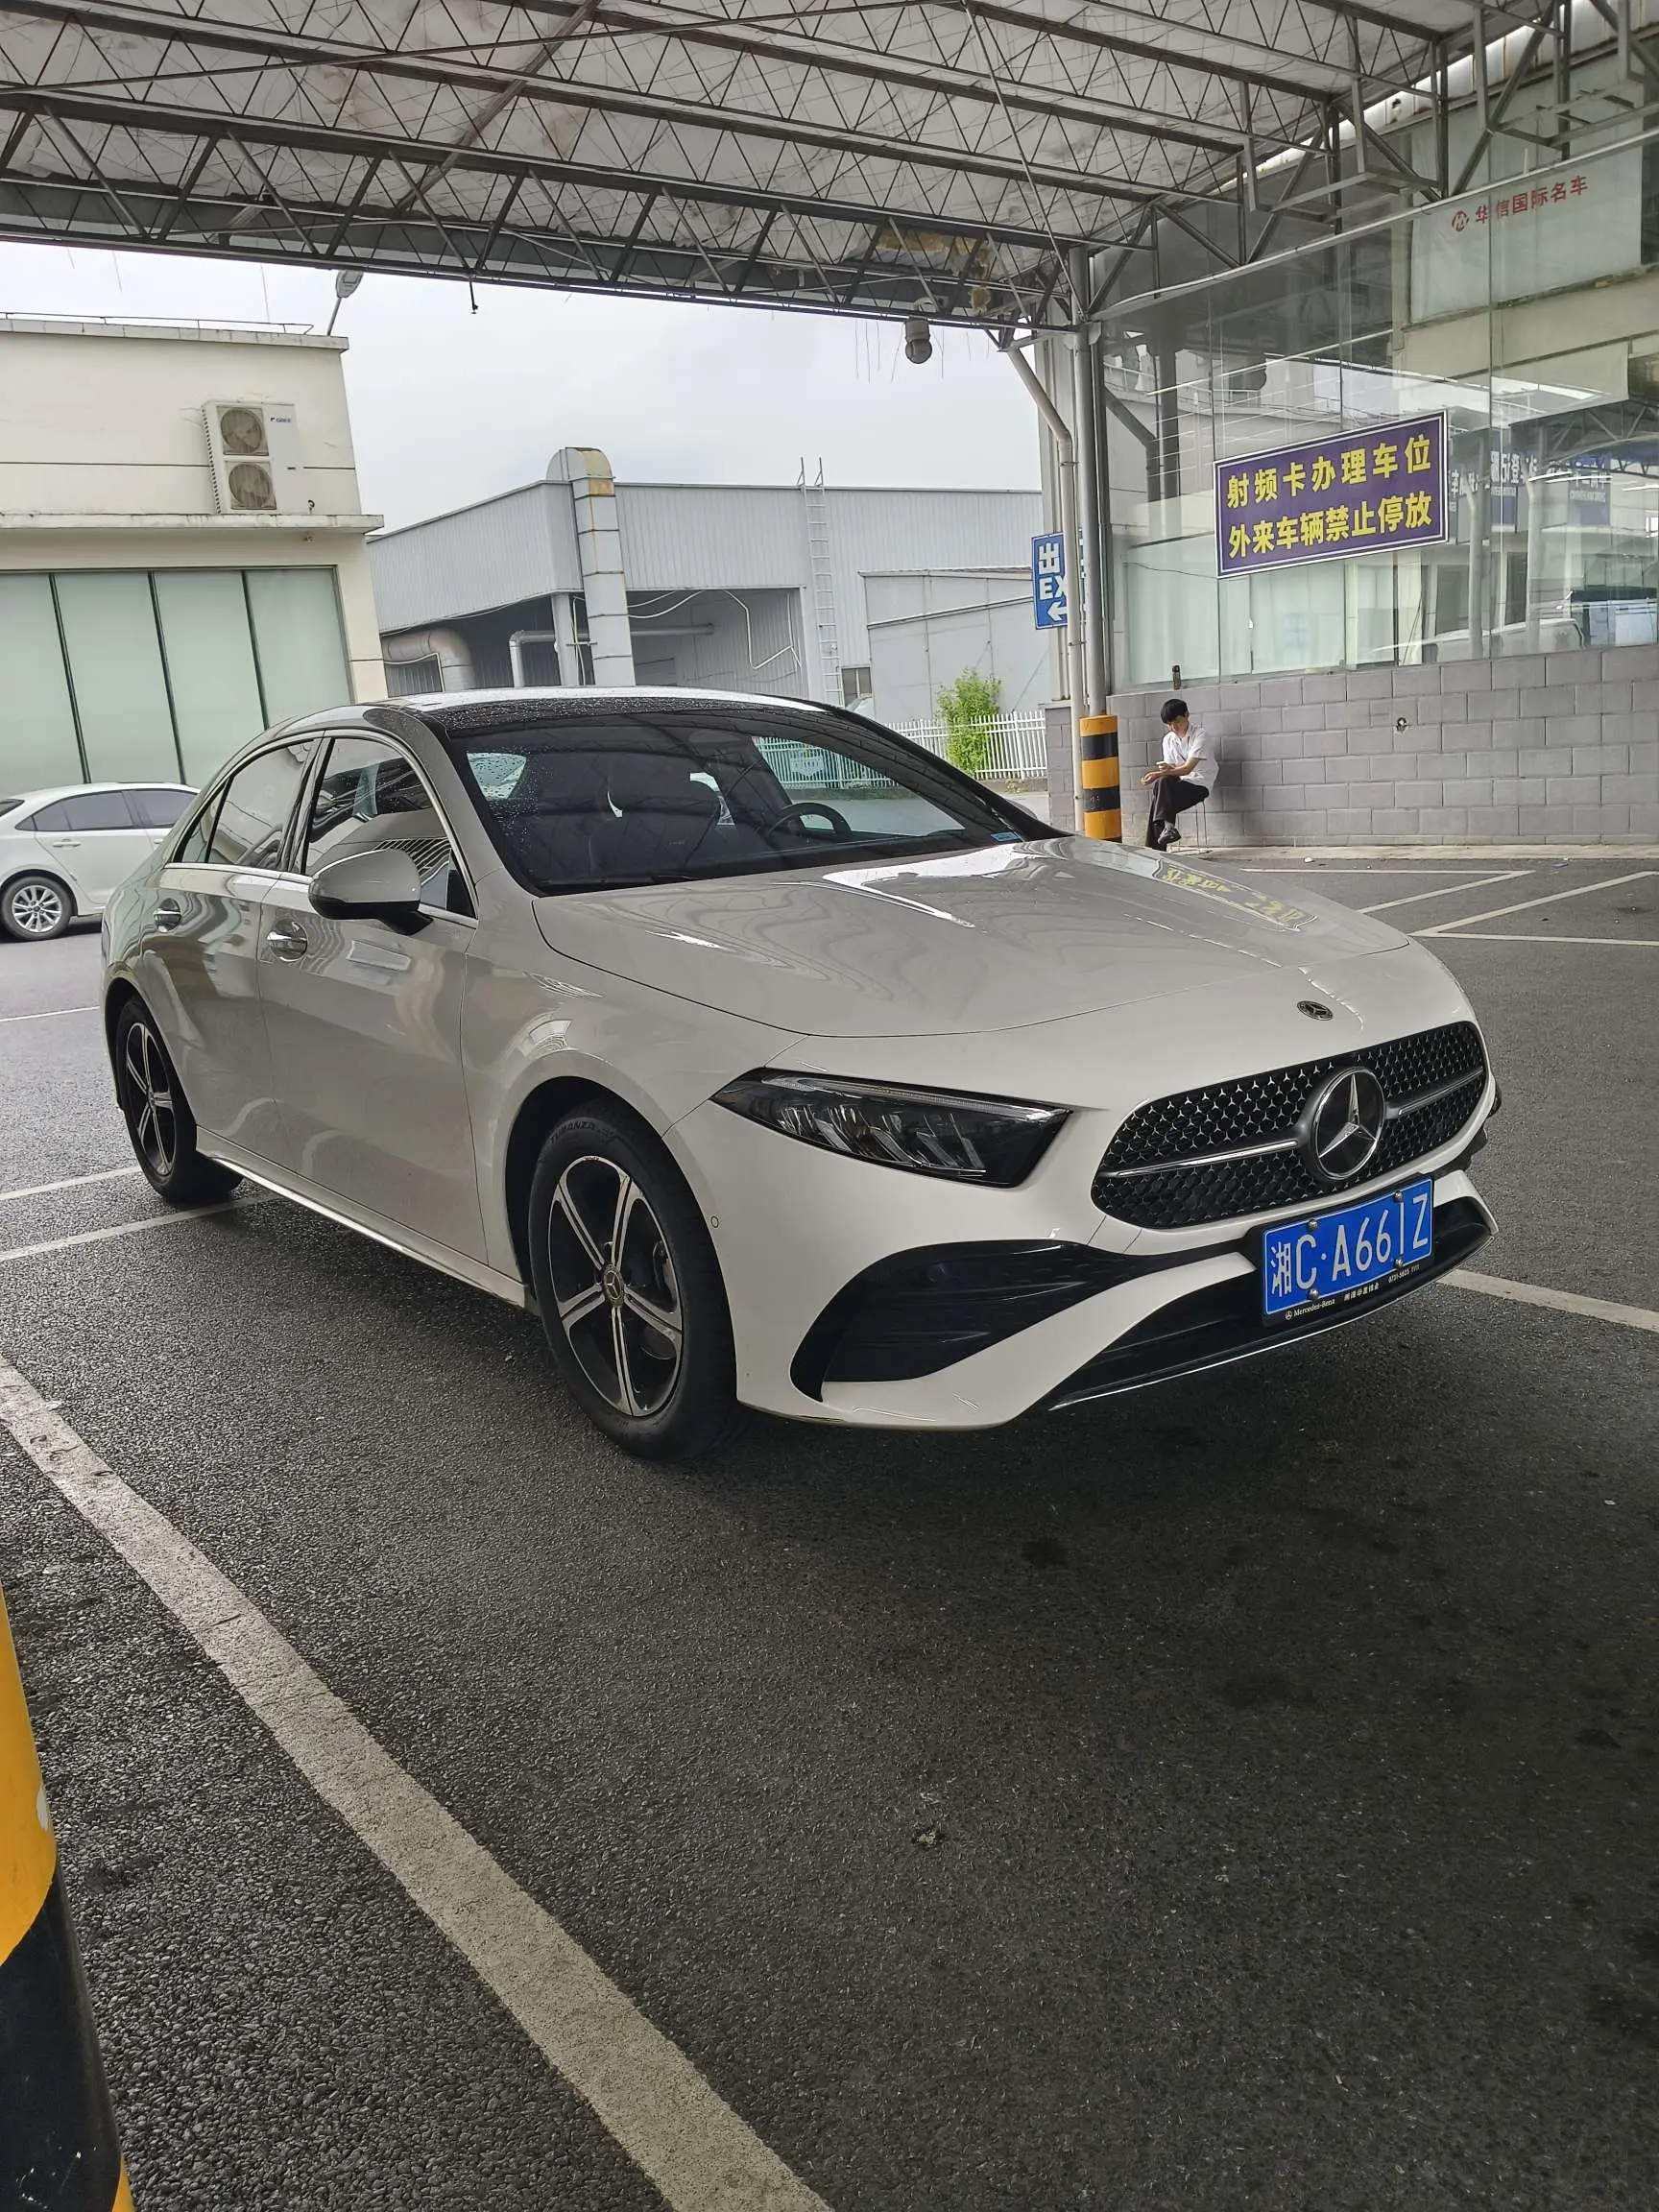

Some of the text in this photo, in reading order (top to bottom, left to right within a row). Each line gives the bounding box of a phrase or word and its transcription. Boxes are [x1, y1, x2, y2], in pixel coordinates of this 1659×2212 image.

[1475, 175, 1588, 224] 华信国际名车
[1226, 433, 1431, 509] 射频卡办理车位
[1228, 490, 1432, 559] 外来车辆禁止停放
[1038, 542, 1061, 574] 出
